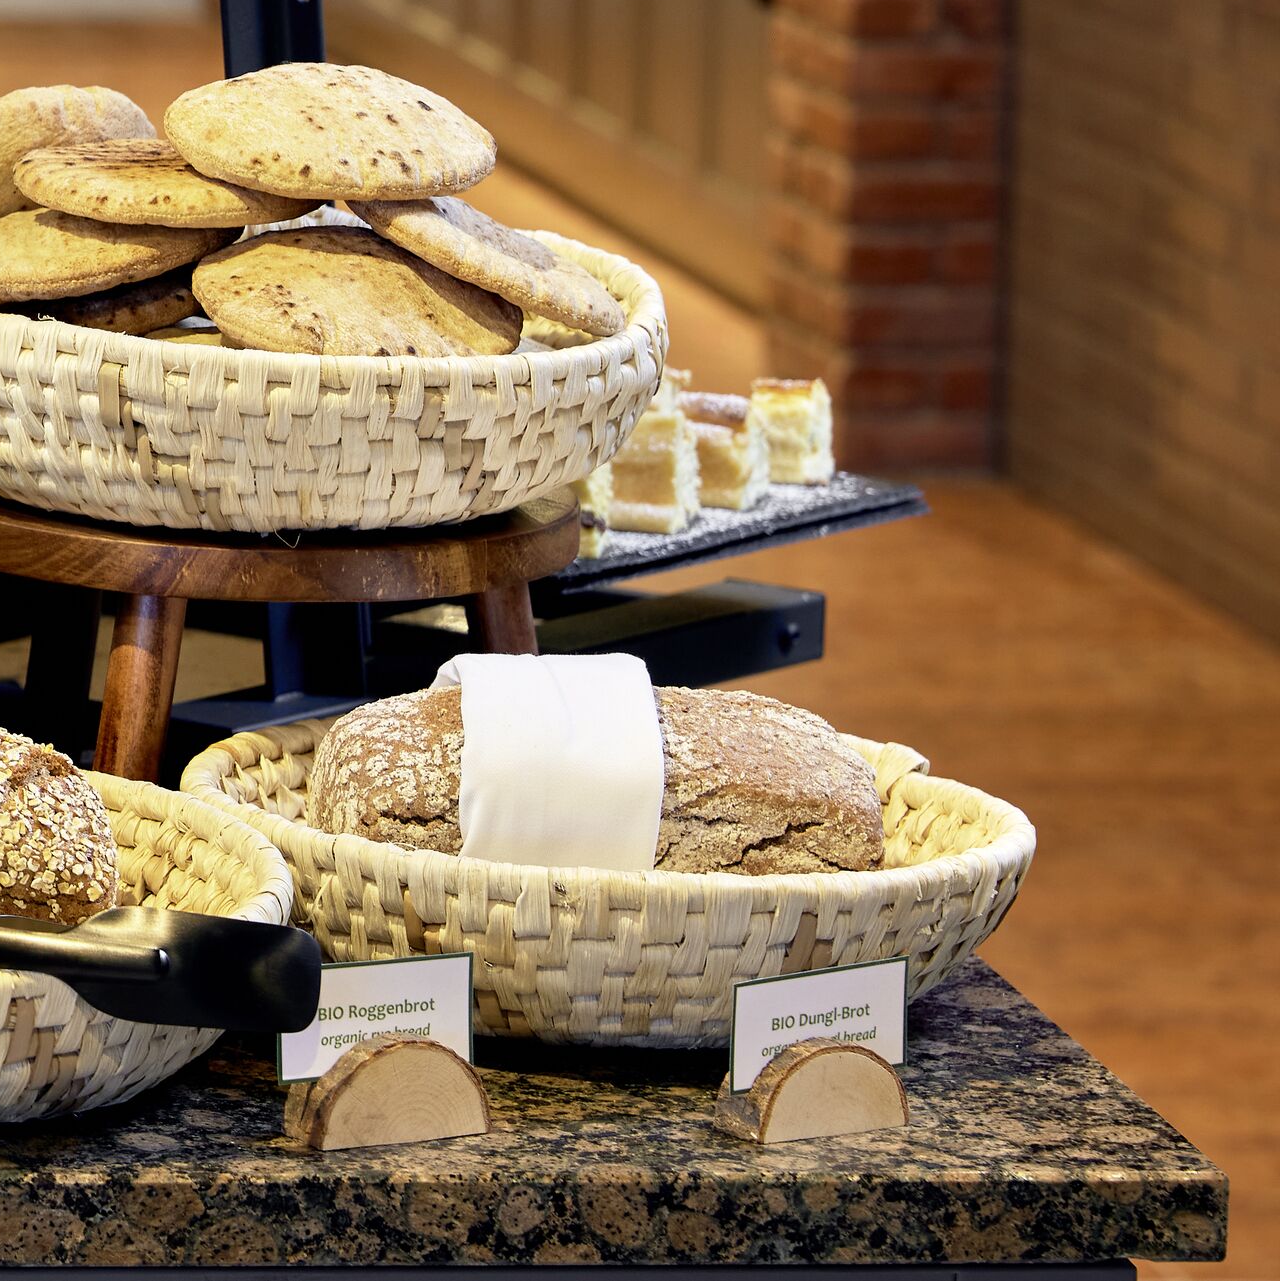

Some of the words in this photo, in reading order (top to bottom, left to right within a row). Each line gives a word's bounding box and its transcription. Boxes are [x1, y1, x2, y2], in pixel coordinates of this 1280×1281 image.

[318, 1006, 344, 1021] BIO
[348, 998, 435, 1021] Roggenbrot
[771, 1015, 795, 1031] BIO
[799, 1003, 870, 1027] Dungl-Brot
[321, 1030, 367, 1049] organic
[843, 1026, 877, 1042] bread
